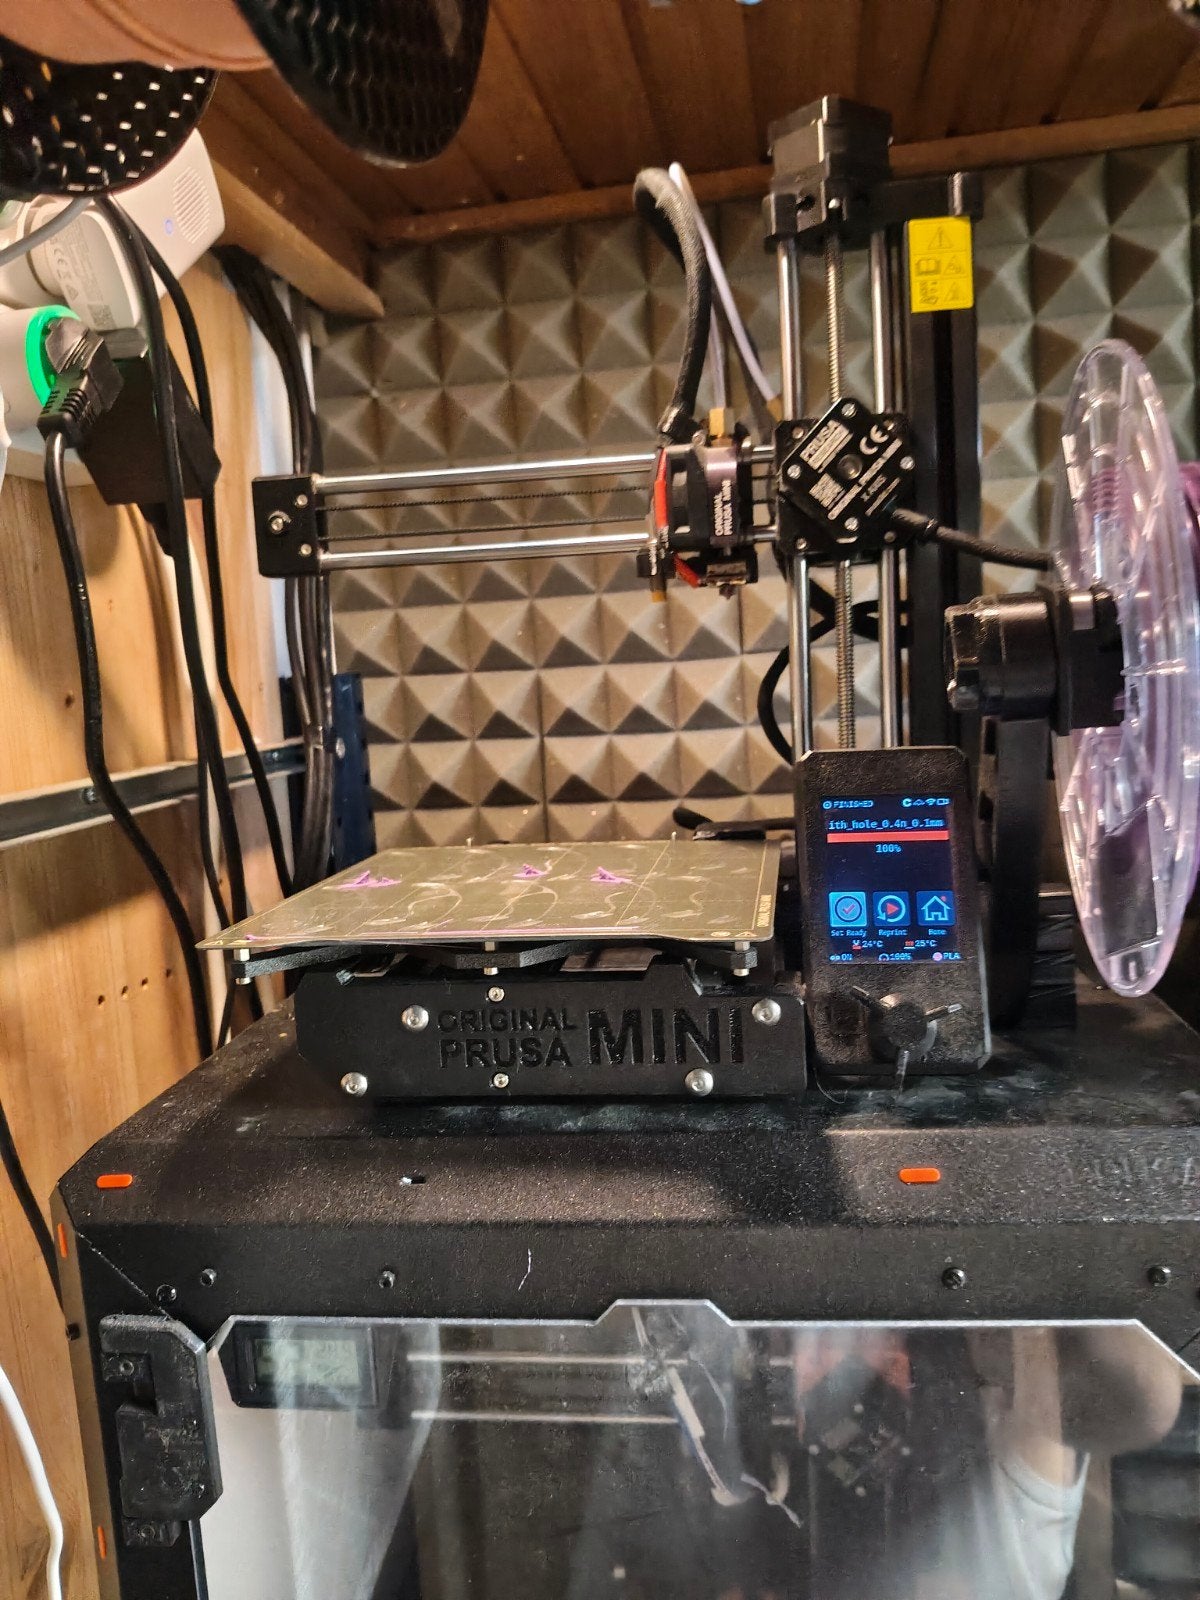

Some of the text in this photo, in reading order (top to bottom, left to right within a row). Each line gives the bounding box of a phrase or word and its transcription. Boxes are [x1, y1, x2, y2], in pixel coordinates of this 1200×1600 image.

[859, 424, 890, 455] CE
[833, 800, 874, 809] FINISHED
[875, 843, 902, 853] 100%
[846, 928, 867, 938] Ready
[878, 928, 909, 938] Reprint
[862, 940, 884, 948] 24°C
[914, 939, 938, 948] 25°C
[943, 952, 962, 960] PLA
[437, 1007, 577, 1033] ORIGINAL
[586, 1008, 745, 1065] MINI
[438, 1037, 573, 1068] PRUSA
